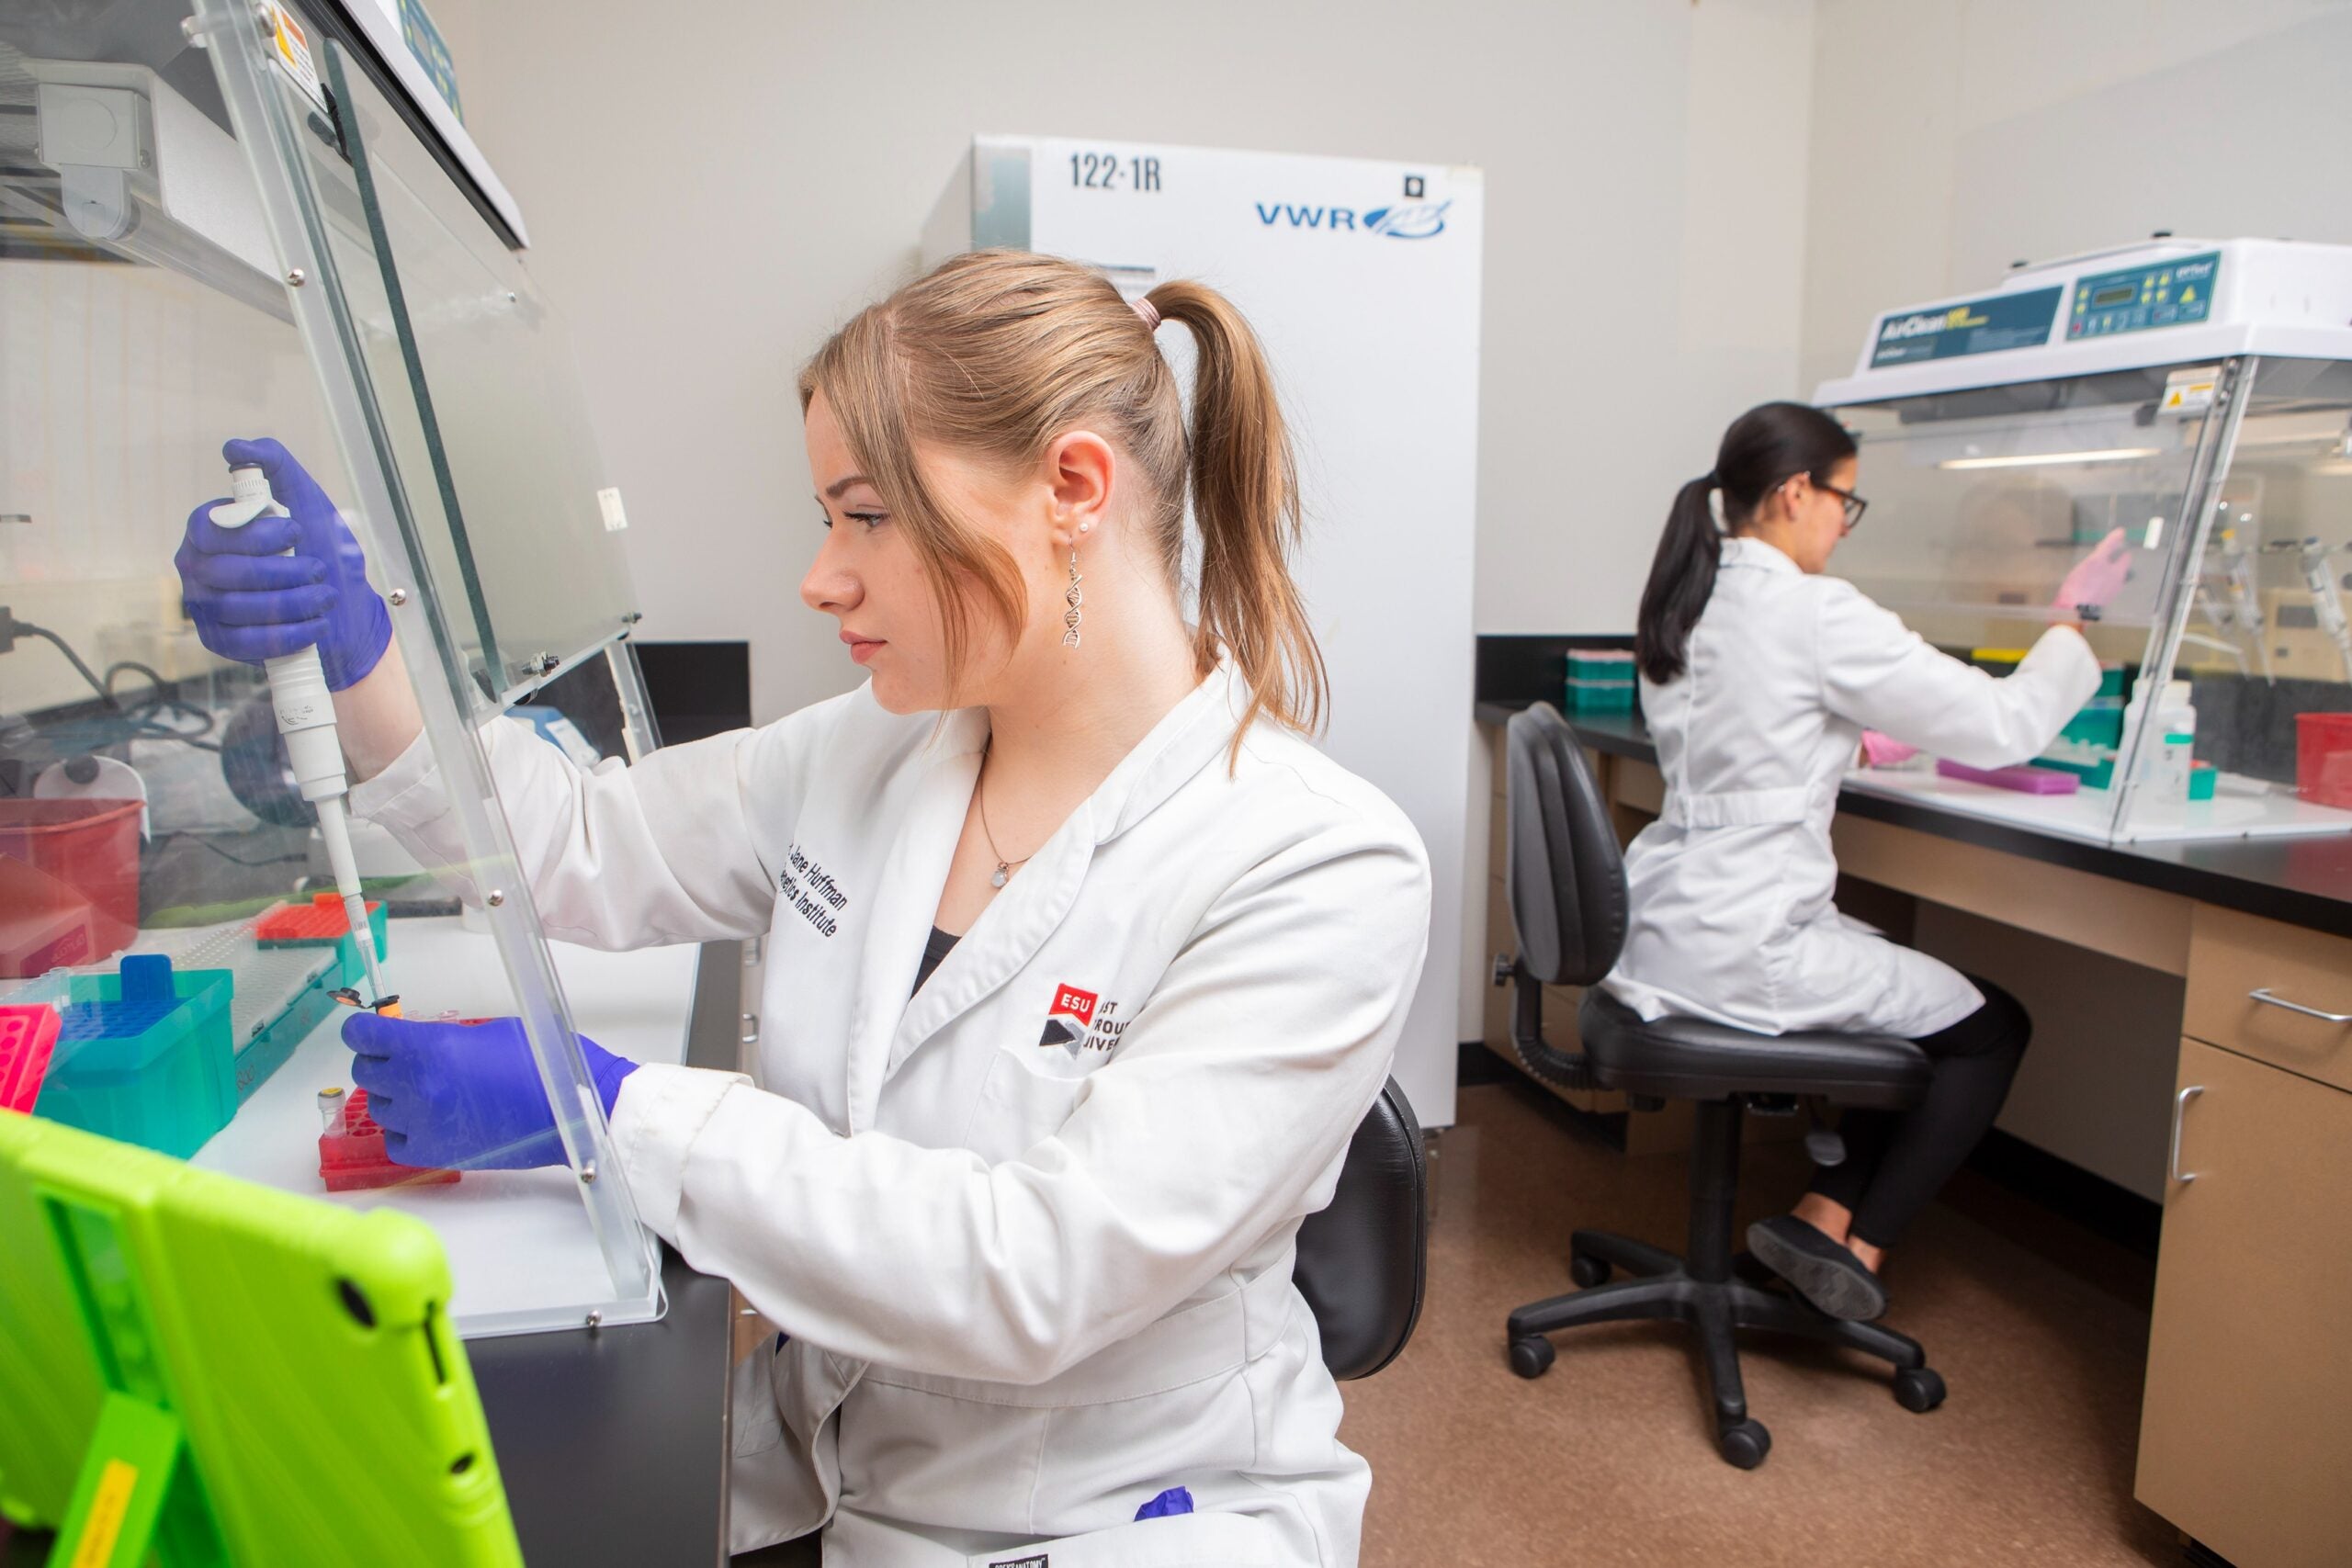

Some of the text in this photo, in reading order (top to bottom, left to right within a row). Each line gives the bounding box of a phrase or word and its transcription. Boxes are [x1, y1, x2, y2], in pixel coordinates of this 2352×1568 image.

[1257, 202, 1354, 230] VWR
[790, 844, 848, 911] Jane Huffman
[795, 891, 837, 937] Institute
[1060, 993, 1091, 1013] ESU
